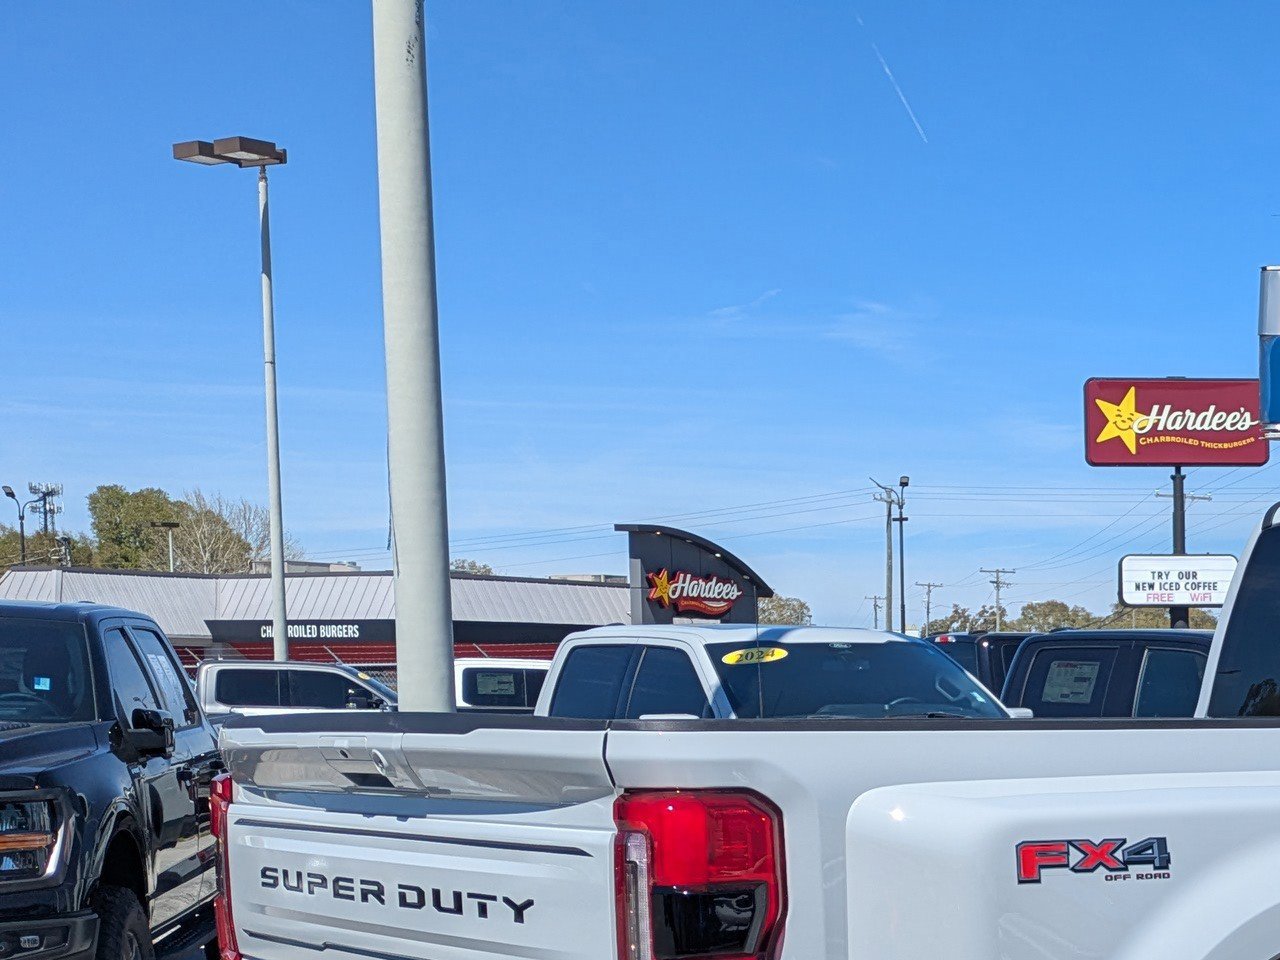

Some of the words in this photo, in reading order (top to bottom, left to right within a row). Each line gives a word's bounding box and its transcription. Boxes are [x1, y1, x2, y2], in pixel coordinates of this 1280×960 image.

[1132, 404, 1261, 434] Hardee's
[1139, 435, 1200, 446] CHARBROILED
[1200, 437, 1255, 449] THICKBURGERS
[1150, 571, 1171, 580] TRY
[1177, 571, 1198, 580] OUR
[668, 573, 743, 600] Hardee's
[1134, 582, 1155, 591] NEW
[1159, 582, 1180, 591] ICED
[1184, 582, 1218, 591] COFFEE
[1146, 593, 1174, 602] FREE
[260, 624, 317, 638] CHROILED
[319, 624, 360, 638] BURGERS
[735, 649, 775, 664] 2024
[1015, 837, 1171, 885] FX4
[1105, 874, 1131, 882] OFF
[1136, 872, 1170, 881] ROAD
[260, 866, 386, 905] SUPER
[397, 883, 534, 924] DUTY
